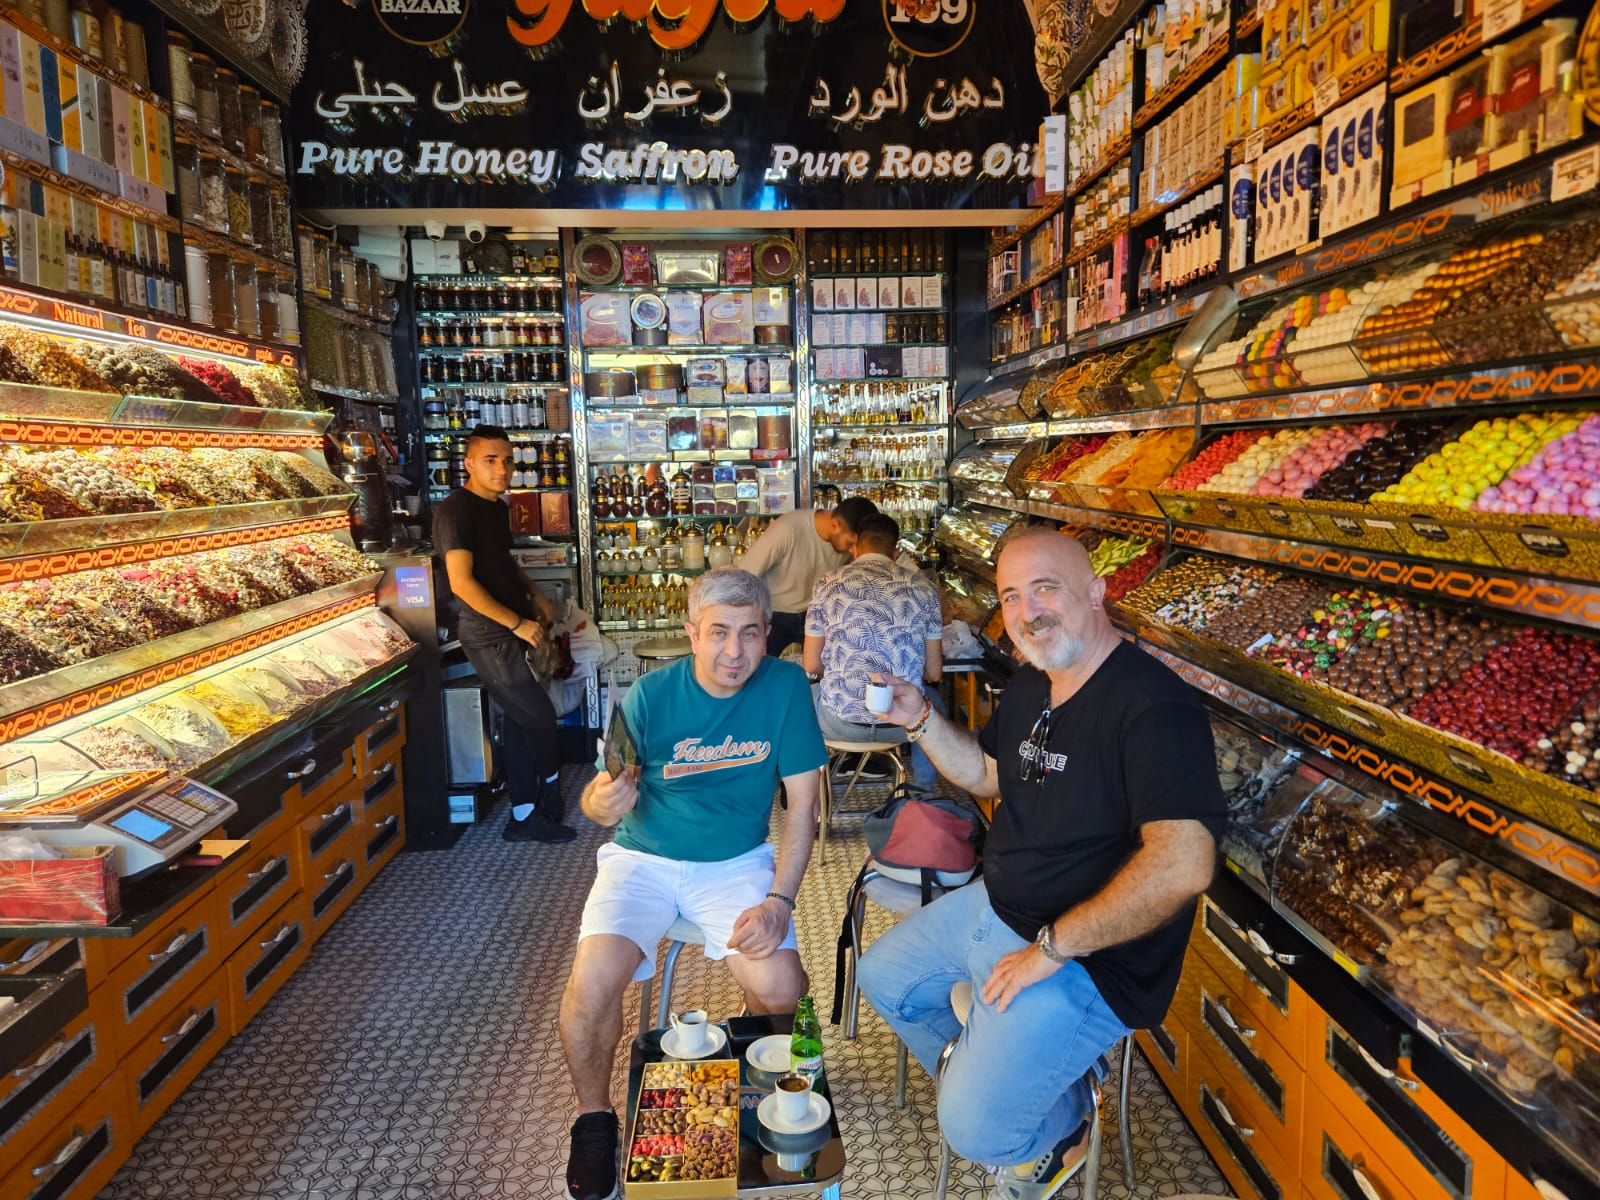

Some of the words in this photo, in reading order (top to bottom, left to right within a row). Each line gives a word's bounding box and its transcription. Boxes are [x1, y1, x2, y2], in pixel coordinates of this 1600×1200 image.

[380, 0, 462, 14] BAZAAR
[432, 58, 529, 112] عسل
[810, 64, 907, 122] الورد
[925, 77, 1004, 121] دهن
[298, 142, 403, 175] Pure
[415, 141, 557, 184] Honey
[575, 141, 739, 180] Saffron
[771, 144, 870, 178] Pure
[879, 144, 972, 178] Rose
[1481, 178, 1541, 216] Spices
[54, 302, 104, 330] Natural
[125, 317, 146, 338] Tea
[673, 735, 770, 762] Freedom
